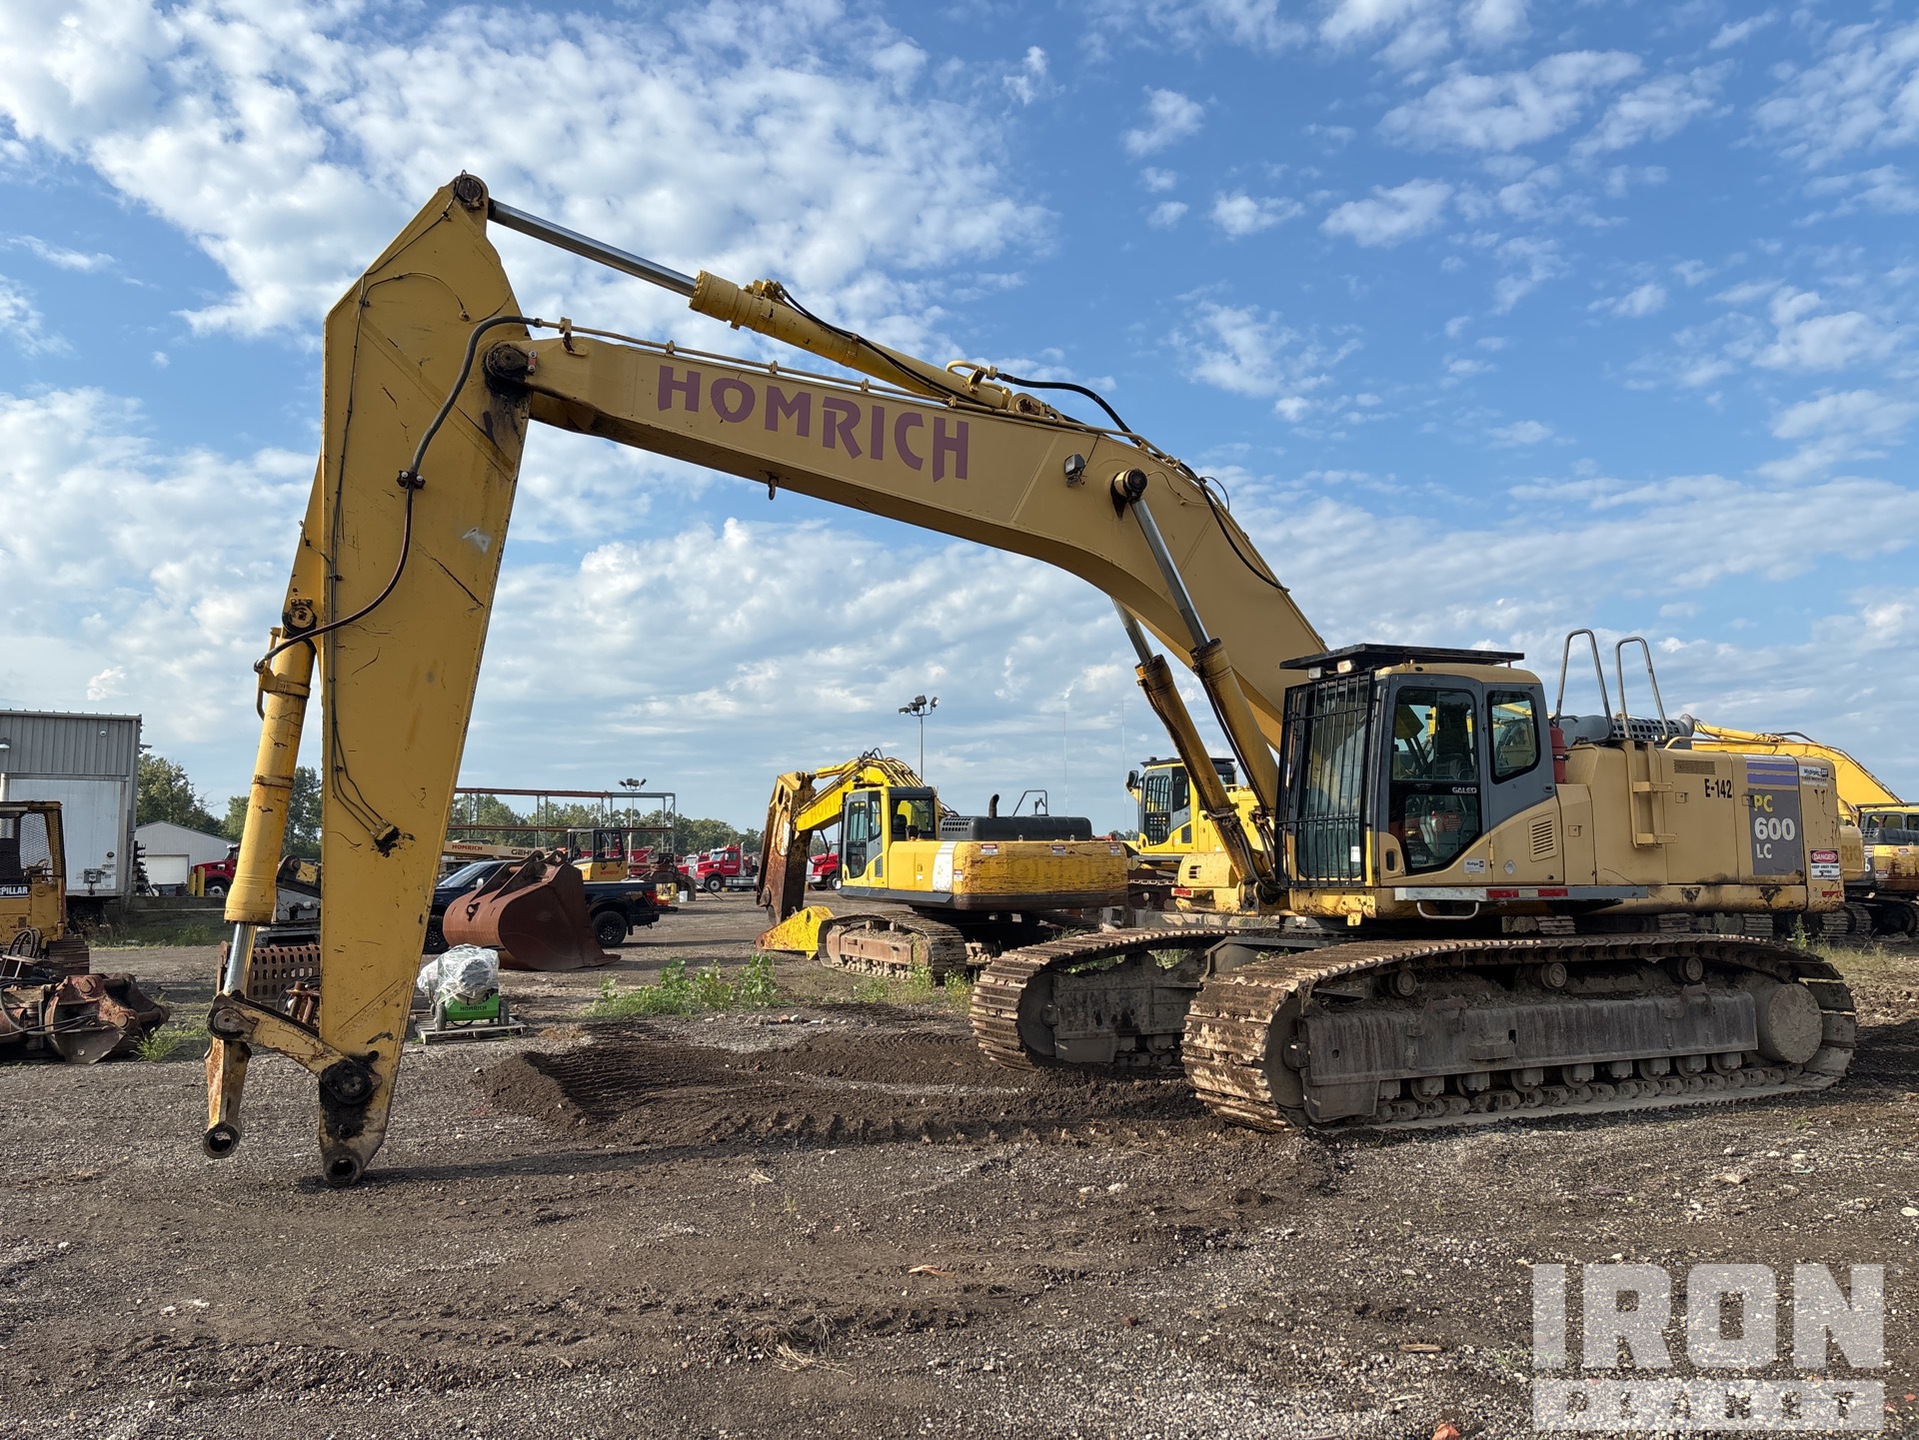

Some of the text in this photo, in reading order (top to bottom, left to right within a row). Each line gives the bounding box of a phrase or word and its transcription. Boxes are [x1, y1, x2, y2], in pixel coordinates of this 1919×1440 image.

[657, 365, 969, 483] HOMRICH
[1704, 778, 1733, 799] E-142
[1753, 794, 1774, 812] PC
[1754, 817, 1796, 841] 600
[1756, 843, 1773, 859] LC
[1812, 852, 1838, 861] DANGER
[0, 886, 28, 895] PILLAR
